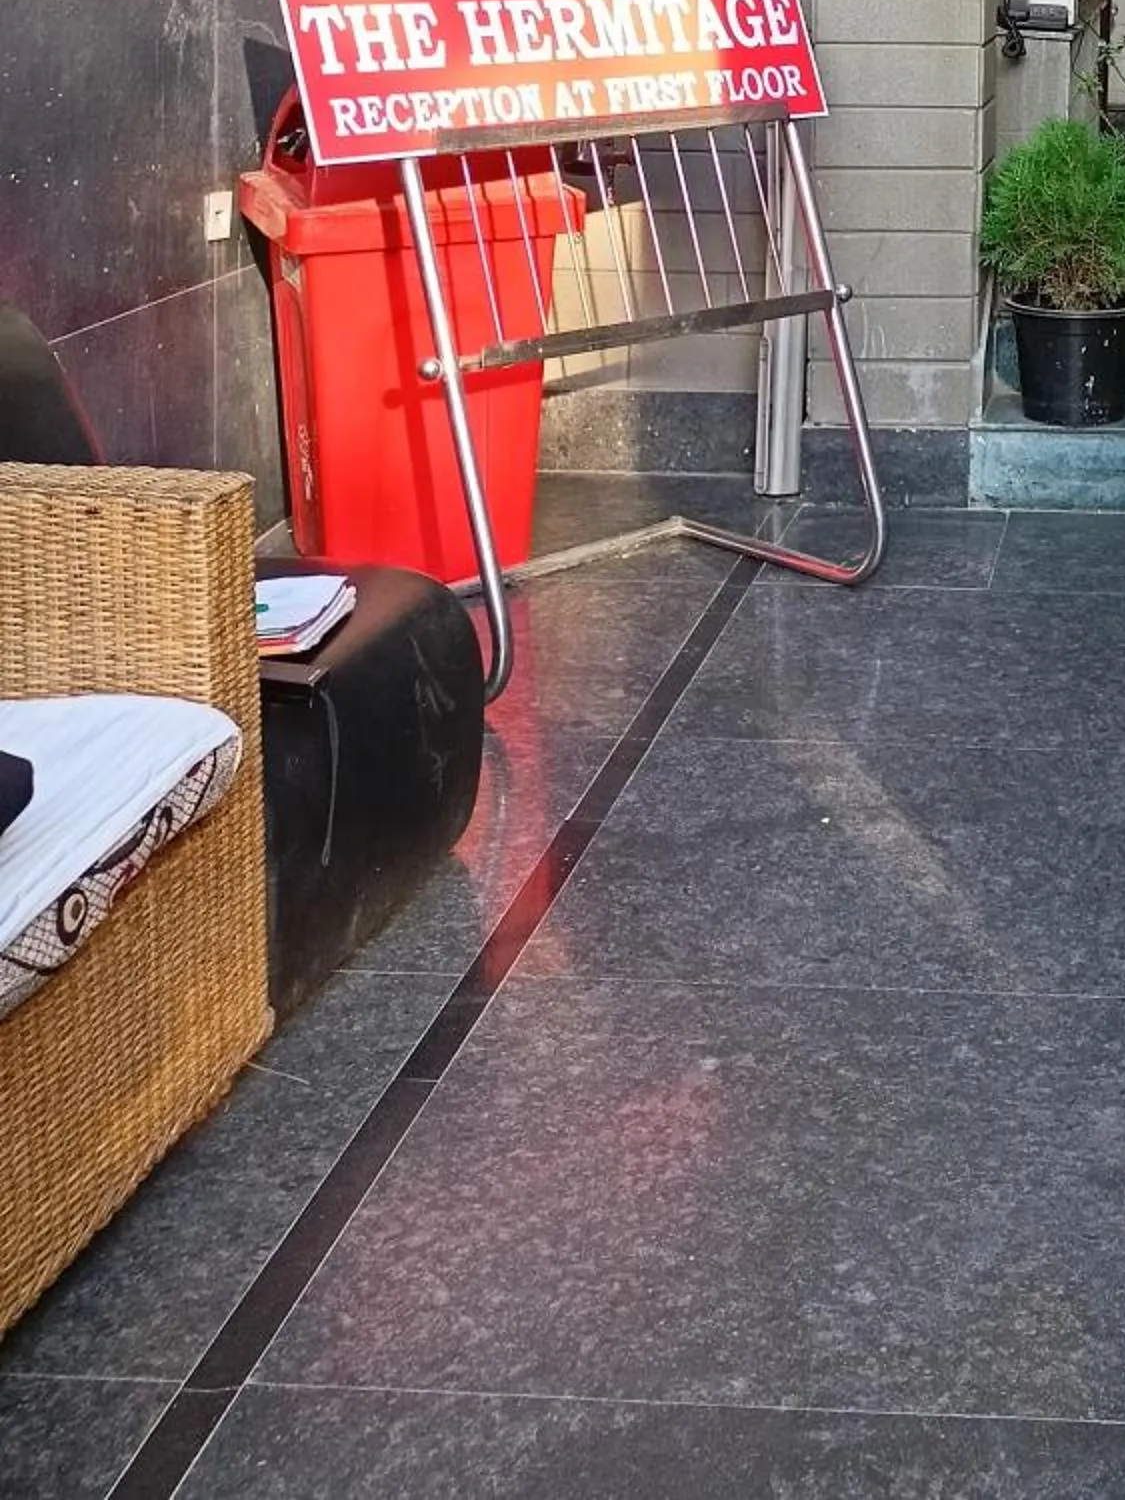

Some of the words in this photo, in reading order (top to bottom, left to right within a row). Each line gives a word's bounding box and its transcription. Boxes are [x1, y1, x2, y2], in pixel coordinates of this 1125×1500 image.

[301, 2, 447, 76] THE
[329, 83, 545, 137] RECEPTION
[555, 77, 596, 118] AT
[604, 69, 698, 115] FIRST
[704, 64, 807, 106] FLOOR
